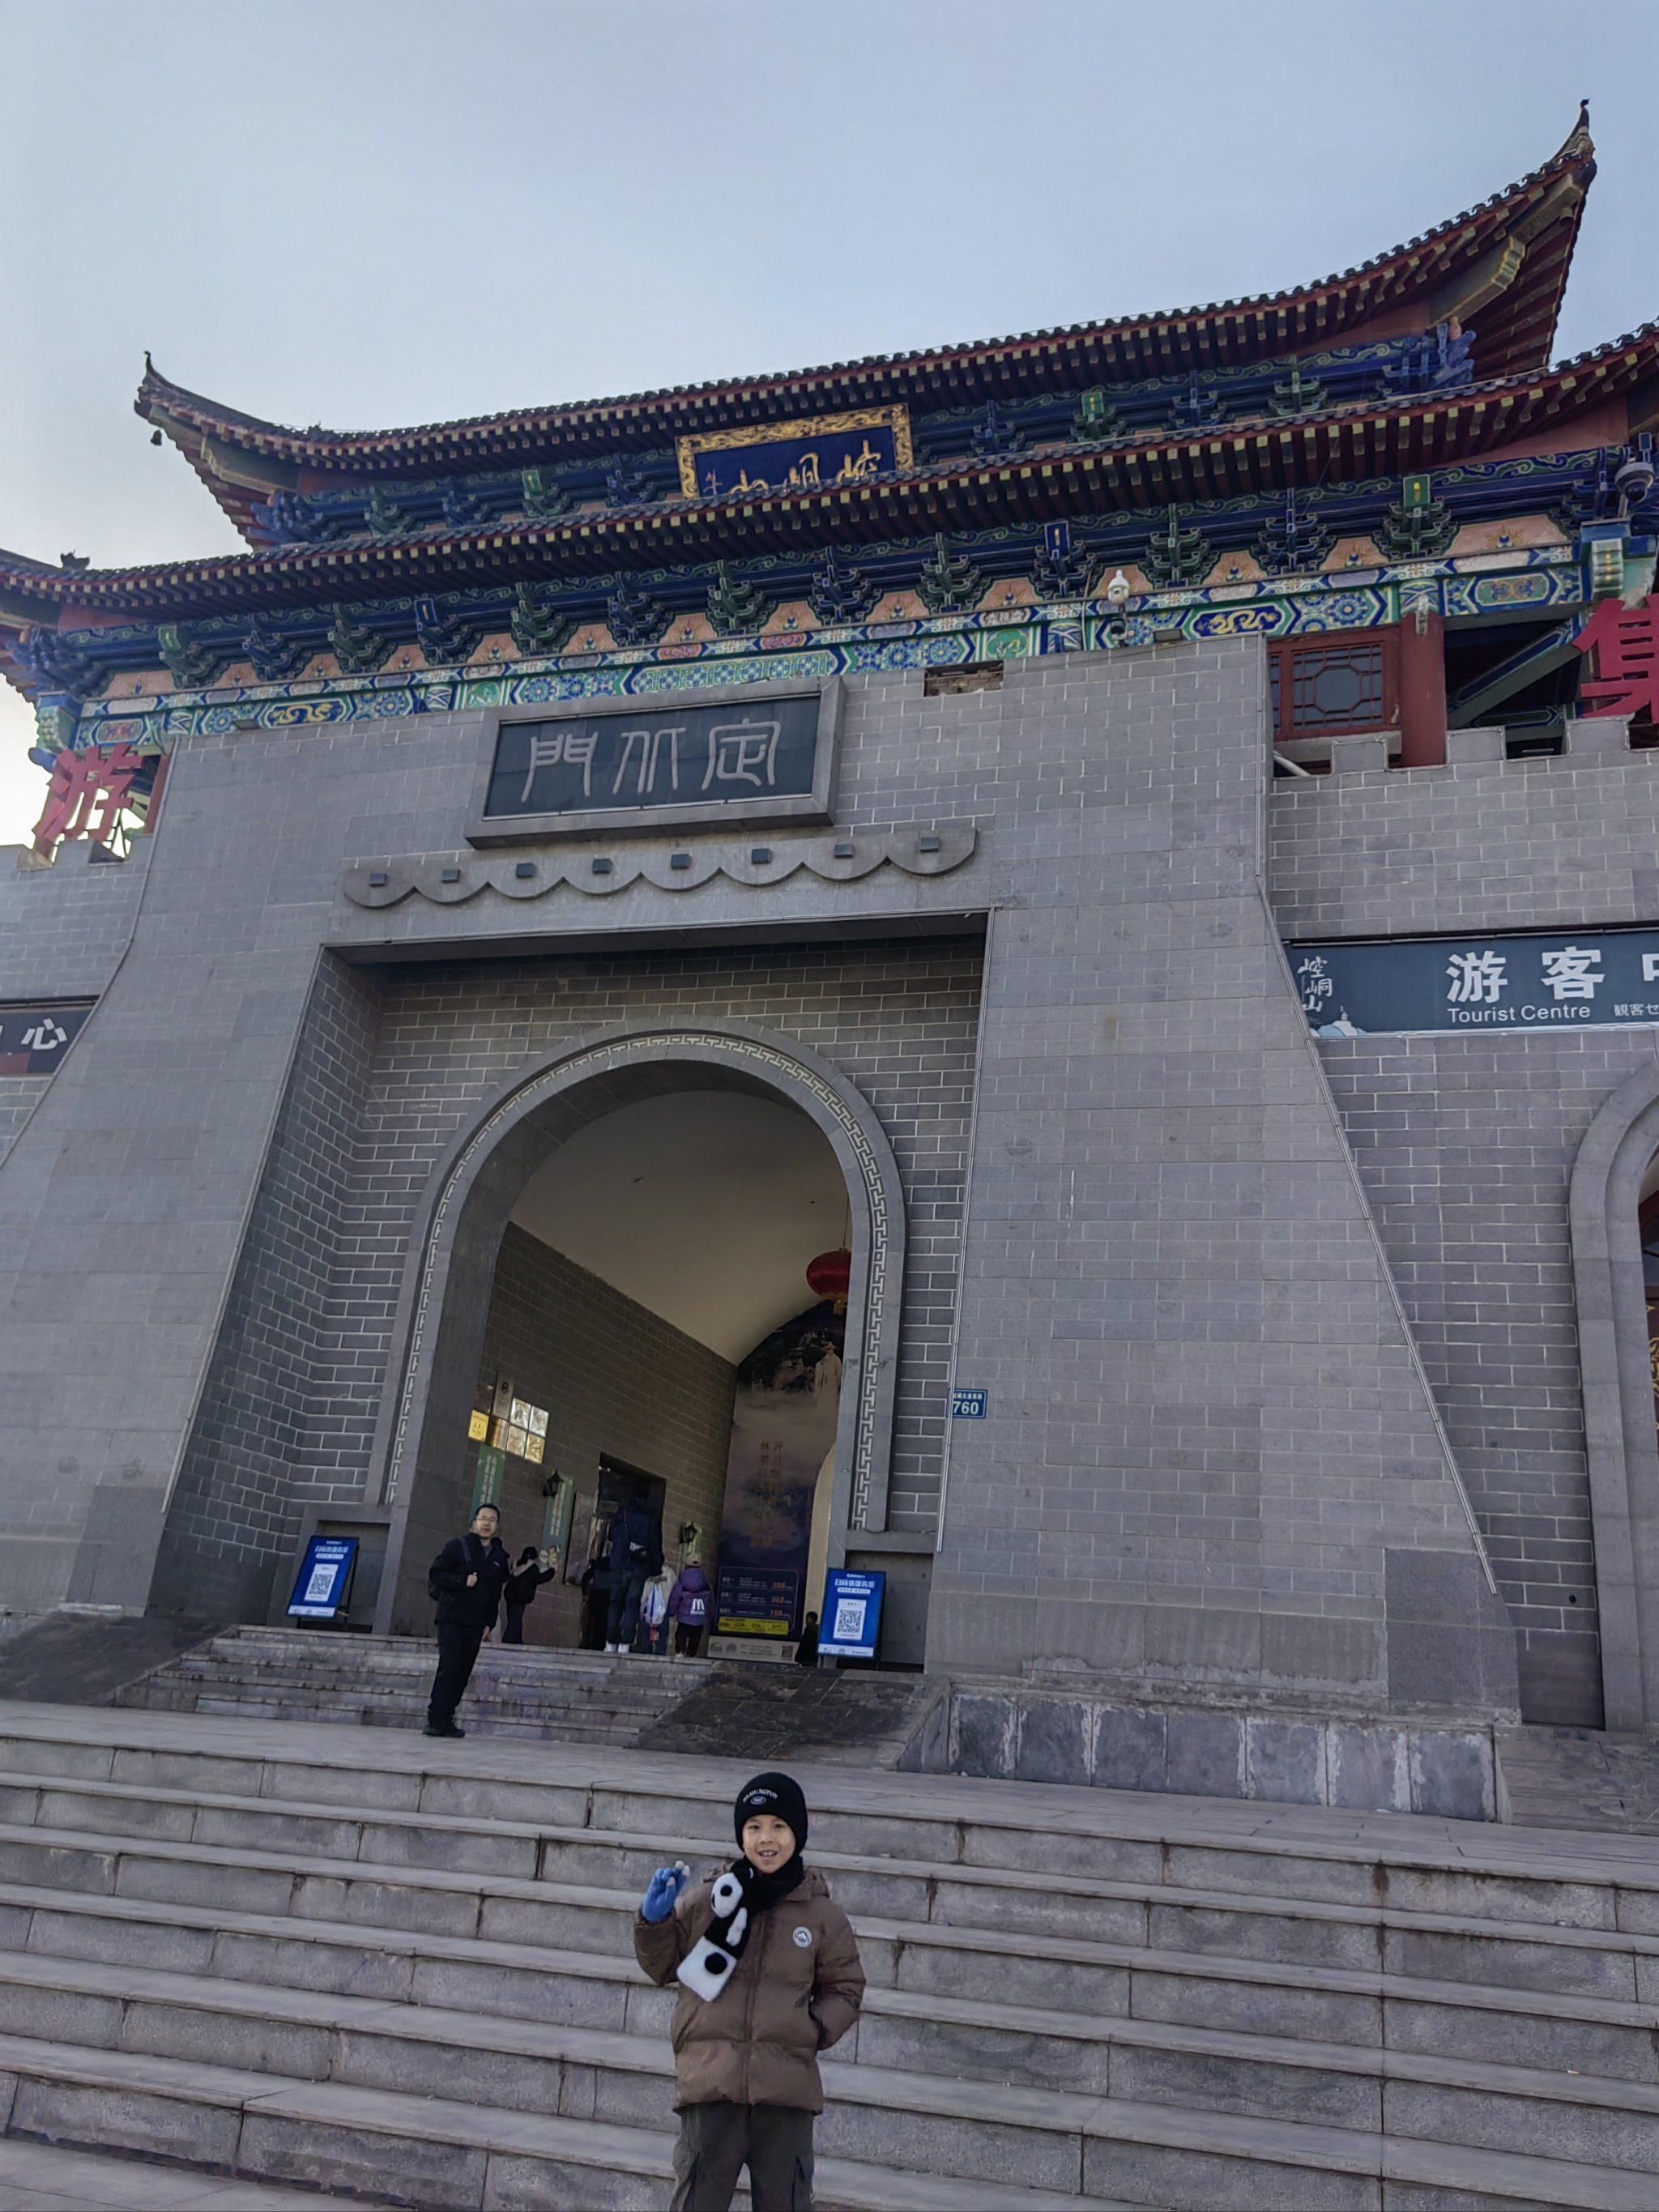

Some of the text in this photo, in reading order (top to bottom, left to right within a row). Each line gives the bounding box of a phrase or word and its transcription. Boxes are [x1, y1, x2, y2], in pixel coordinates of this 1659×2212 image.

[32, 743, 143, 857] 游
[1297, 956, 1333, 1012] 崆峒山
[1448, 1004, 1590, 1023] Tourist Centre
[953, 1400, 979, 1414] 760
